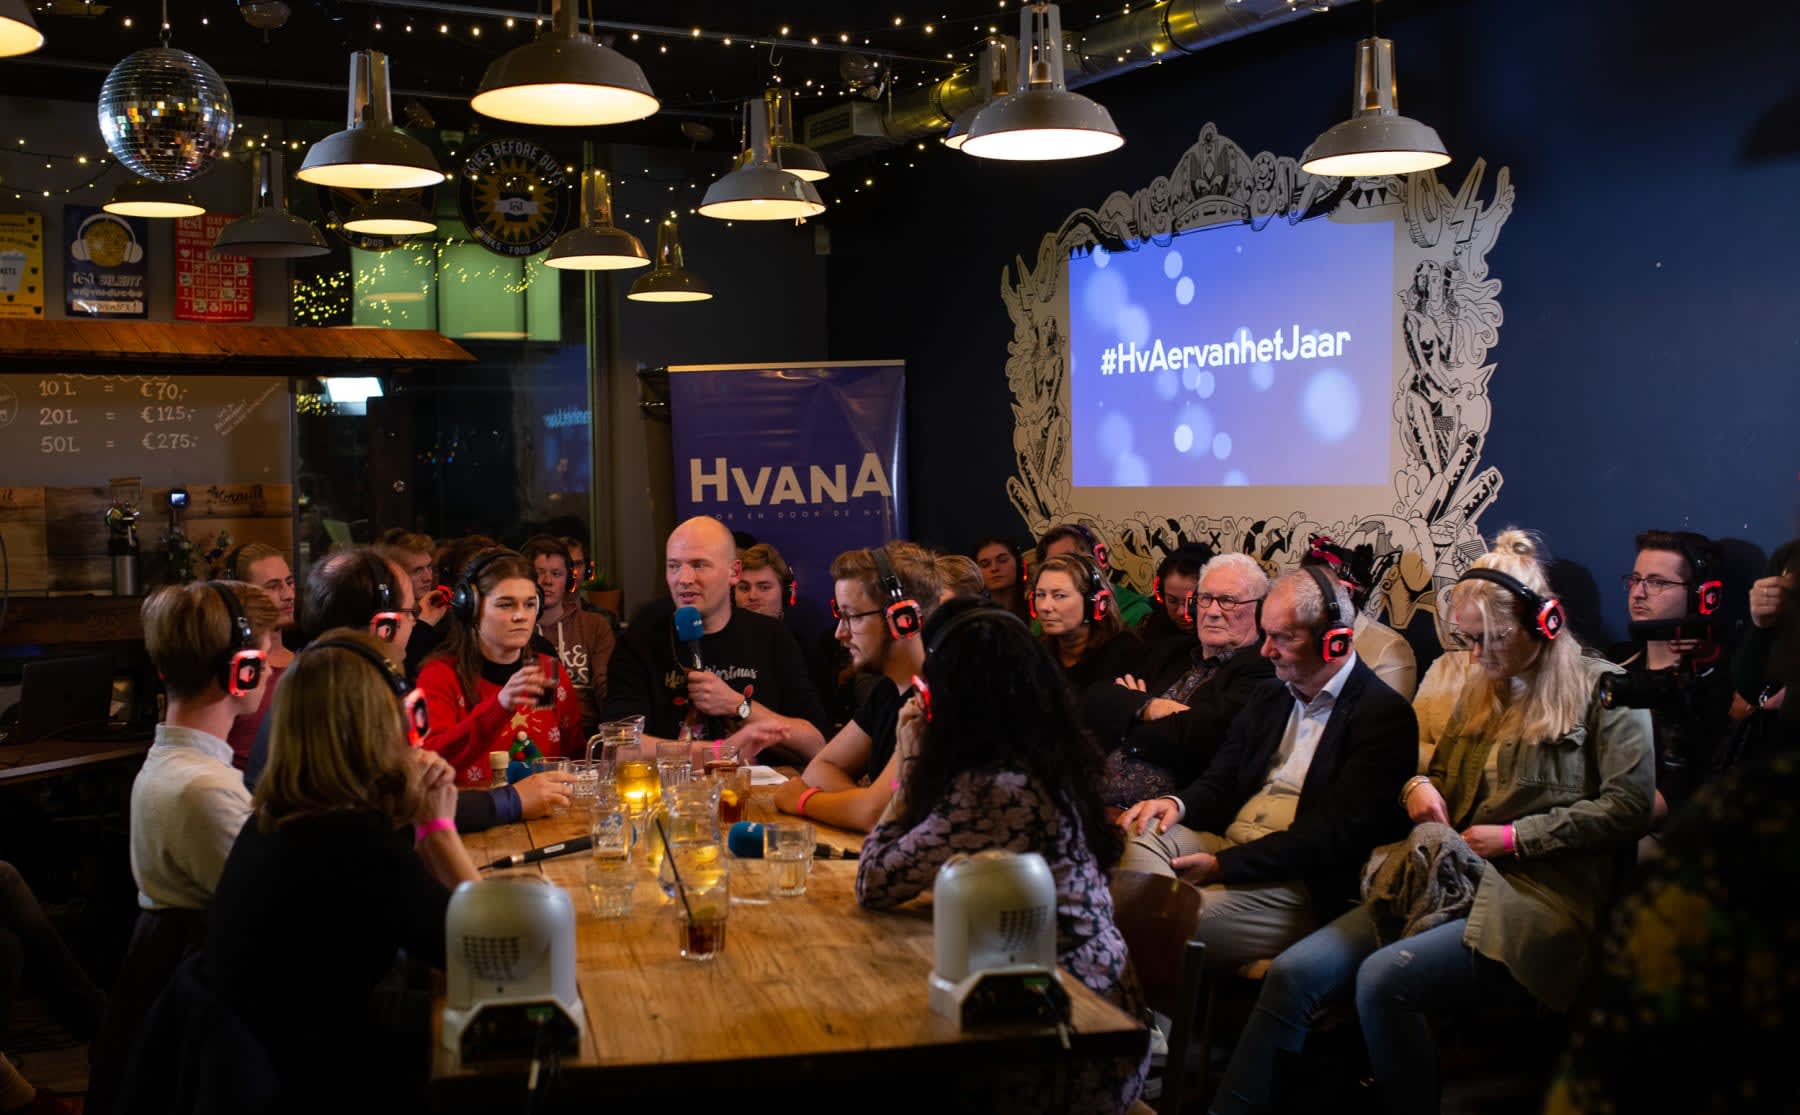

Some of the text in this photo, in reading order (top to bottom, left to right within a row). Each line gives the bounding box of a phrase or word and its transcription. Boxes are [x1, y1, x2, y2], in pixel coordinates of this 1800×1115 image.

[491, 141, 540, 159] BEFORE
[539, 153, 565, 187] GUYS
[1100, 323, 1352, 376] #HvAervanhetJaar
